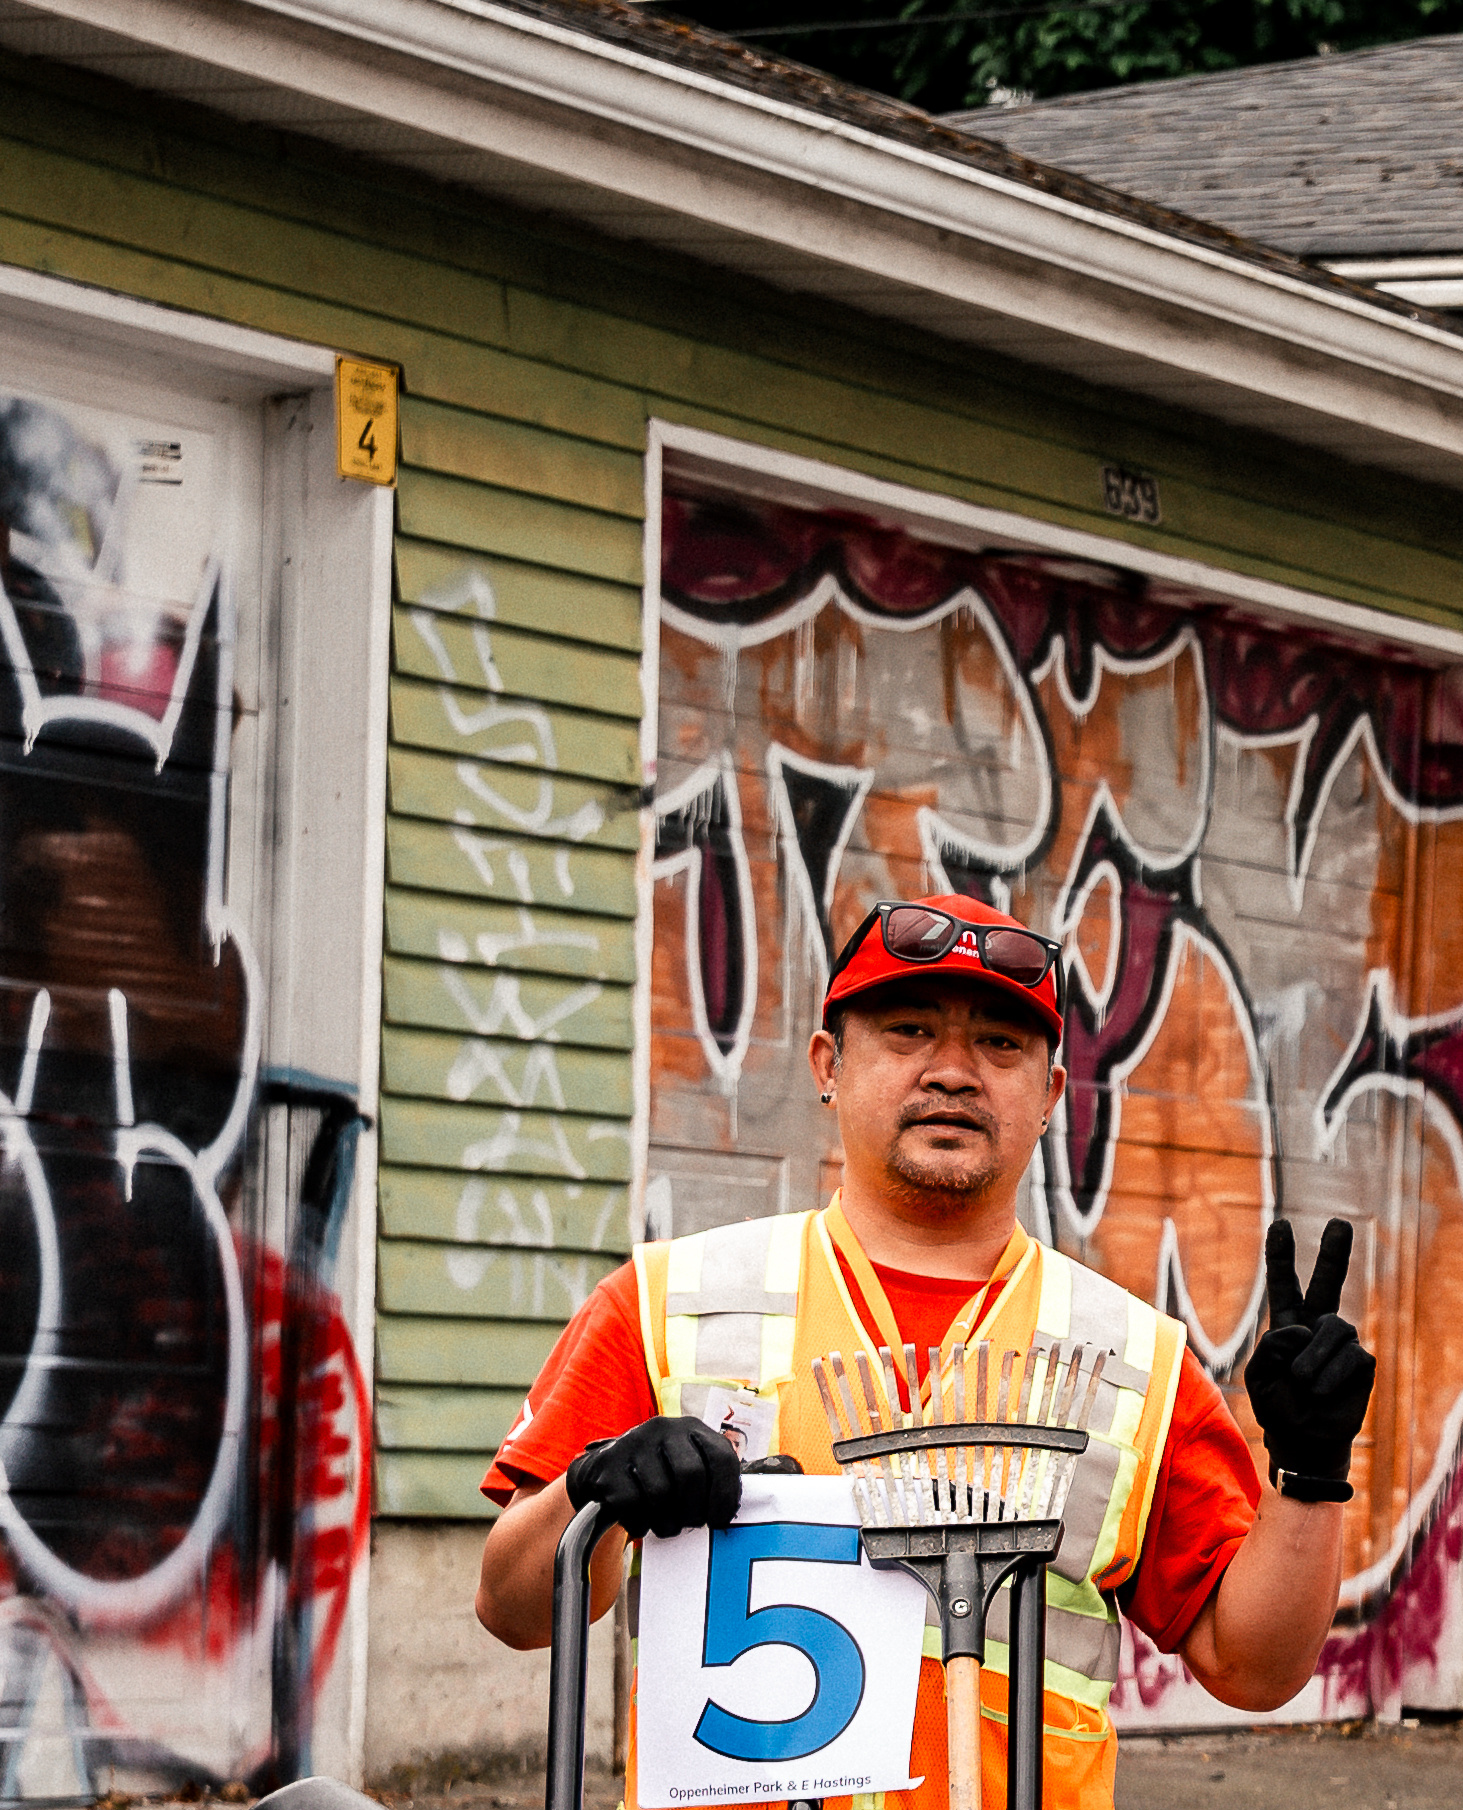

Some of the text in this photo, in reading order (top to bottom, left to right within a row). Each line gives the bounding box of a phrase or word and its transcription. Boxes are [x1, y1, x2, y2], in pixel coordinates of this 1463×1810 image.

[358, 418, 378, 461] 4
[1103, 467, 1158, 520] 639
[692, 1520, 867, 1763] 5
[669, 1775, 872, 1801] Oppenheimer Park & E Hastings
